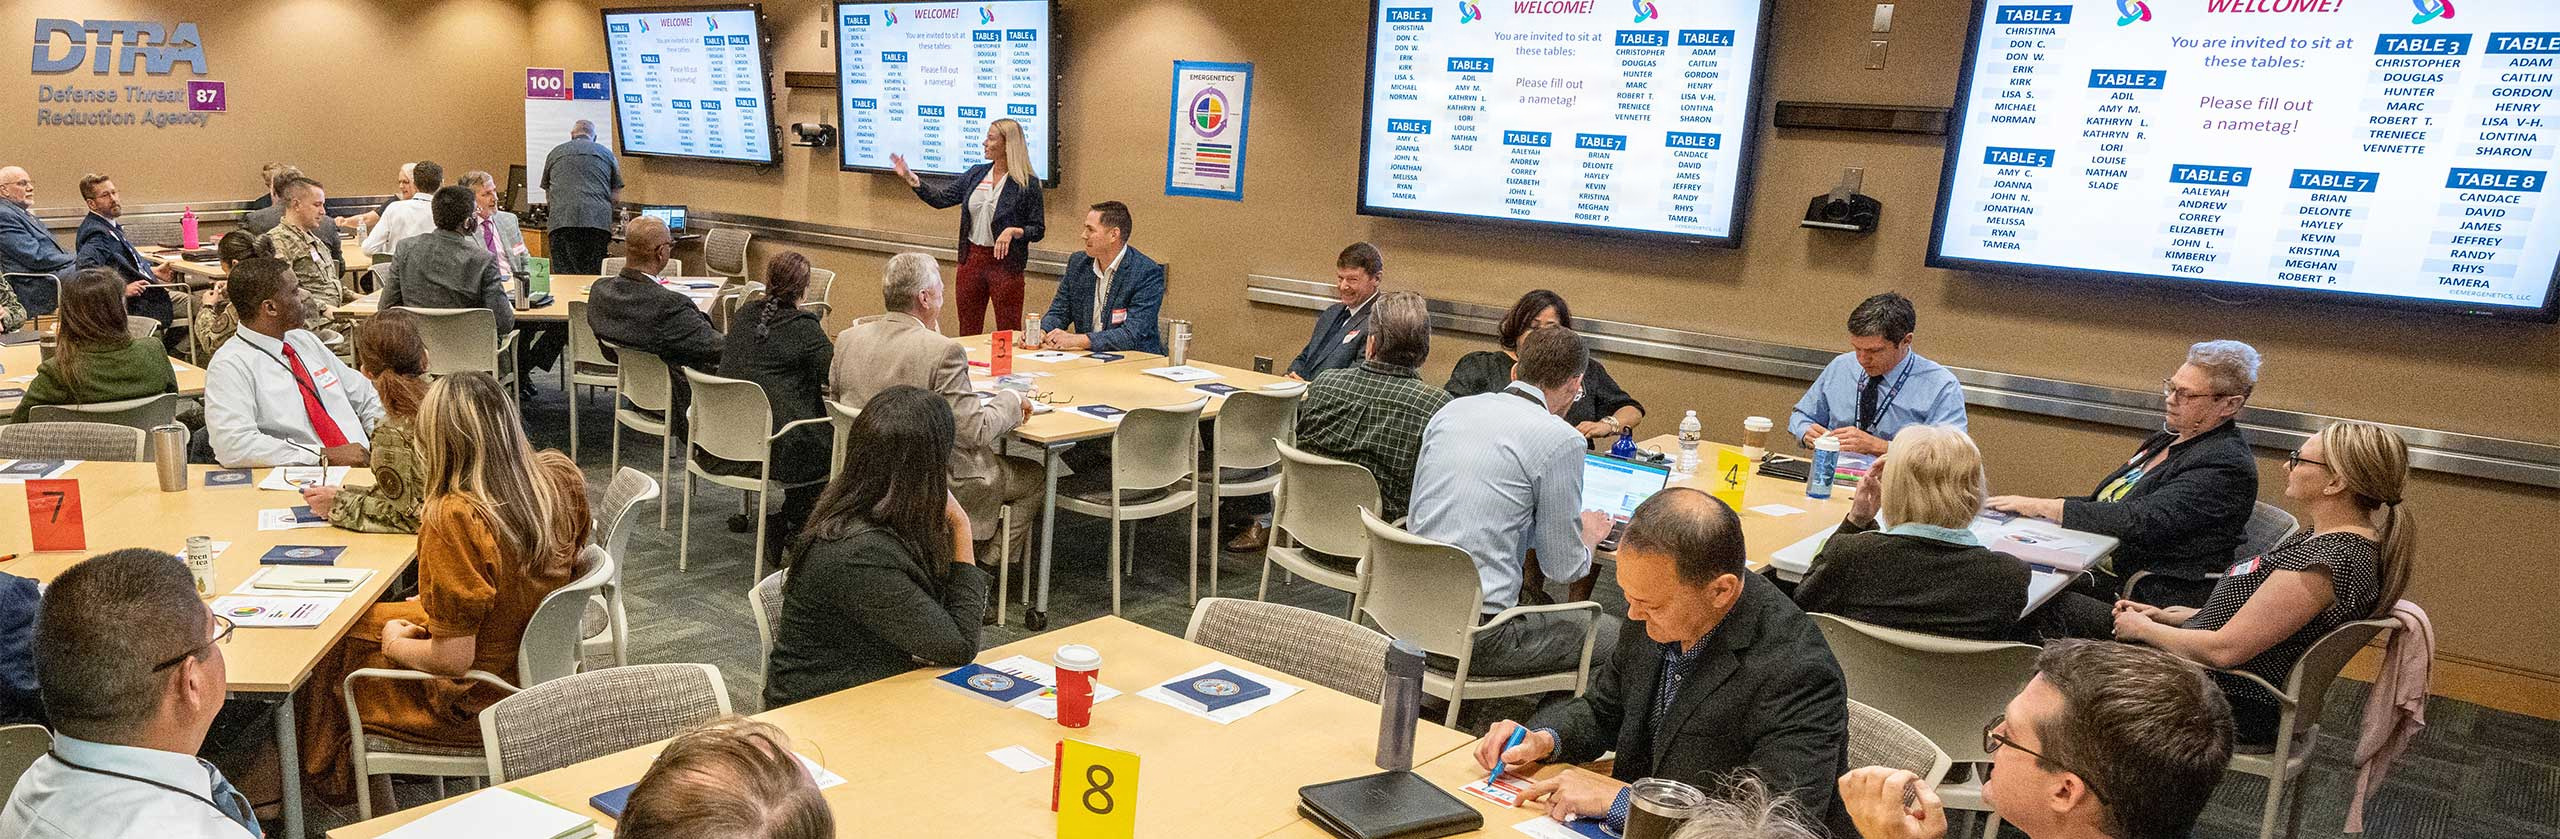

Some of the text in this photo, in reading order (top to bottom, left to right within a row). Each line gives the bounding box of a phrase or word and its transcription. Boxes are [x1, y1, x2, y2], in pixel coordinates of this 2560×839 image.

[1514, 1, 1594, 14] WELCOME!
[2207, 0, 2344, 13] WELCOME!
[914, 8, 959, 19] WELCOME!
[2006, 10, 2062, 22] TABLE 1
[1010, 32, 1029, 40] TABLE
[2005, 27, 2056, 36] CHRISTINA
[975, 33, 994, 41] TABLE
[1494, 32, 1512, 40] You
[1530, 32, 1564, 41] invited
[1566, 33, 1577, 42] to
[1578, 32, 1590, 42] sit
[1592, 33, 1602, 42] at
[1621, 34, 1663, 46] TABLE 3
[1684, 34, 1728, 46] TABLE 4
[31, 18, 208, 75] DTRA
[2010, 40, 2046, 49] DON C.
[2171, 36, 2354, 50] You are invited to sit at
[2386, 38, 2460, 54] TABLE 3
[2497, 37, 2560, 51] TABLE
[1516, 47, 1576, 56] these tables:
[2006, 53, 2045, 61] DON W.
[2204, 55, 2305, 68] these tables:
[2375, 59, 2461, 68] CHRISTOPHER
[2509, 58, 2553, 67] ADAM
[2012, 66, 2034, 74] ERIK
[2009, 78, 2032, 86] KIRK
[2096, 73, 2157, 86] TABLE 2
[2383, 73, 2444, 82] DOUGLAS
[2500, 73, 2553, 82] CAITLIN
[530, 76, 561, 90] 100
[1516, 78, 1583, 89] Please fill out
[38, 84, 184, 104] Defense Threat
[196, 89, 217, 103] 87
[2002, 90, 2034, 99] LISA S.
[2110, 92, 2134, 100] ADIL
[2384, 88, 2435, 97] HUNTER
[2492, 88, 2553, 98] GORDON
[1528, 95, 1576, 106] nametag!
[2200, 96, 2314, 112] Please fill out
[1994, 103, 2037, 112] MICHAEL
[2098, 104, 2141, 114] AMY M.
[2386, 102, 2425, 111] MARC
[2494, 102, 2541, 112] HENRY
[920, 108, 938, 116] TABLE
[37, 109, 209, 129] Reduction Agency
[1991, 115, 2036, 124] NORMAN
[2086, 117, 2148, 127] KATHRYN L.
[2369, 116, 2433, 126] ROBERT T.
[2482, 118, 2544, 128] LISA V-H.
[2202, 120, 2299, 136] a nametag!
[2082, 130, 2146, 140] KATHRYN R.
[2369, 130, 2426, 140] TRENIECE
[2479, 132, 2538, 142] LONTINA
[1671, 135, 1716, 147] TABLE 8
[2100, 143, 2123, 152] LORI
[2362, 144, 2426, 154] VENNETTE
[2476, 146, 2532, 157] SHARON
[1991, 152, 2047, 167] TABLE 5
[2091, 156, 2127, 165] LOUISE
[1997, 168, 2033, 178] AMY C.
[2085, 168, 2128, 178] NATHAN
[2178, 168, 2242, 183] TABLE 6
[1994, 180, 2032, 190] JOANNA
[2299, 174, 2369, 192] TABLE 7
[2456, 172, 2536, 188] TABLE 8
[2088, 181, 2120, 190] SLADE
[1990, 192, 2030, 202] JOHN N.
[2182, 187, 2230, 198] AALEYAH
[2310, 194, 2348, 203] BRIAN
[2458, 192, 2521, 204] CANDACE
[1983, 204, 2034, 215] JONATHAN
[2178, 200, 2228, 210] ANDREW
[2299, 206, 2352, 218] DELONTE
[2464, 207, 2506, 218] DAVID
[1986, 216, 2026, 226] MELISSA
[2179, 212, 2222, 223] CORREY
[2300, 220, 2344, 230] HAYLEY
[2458, 222, 2502, 232] JAMES
[1991, 228, 2016, 238] RYAN
[2169, 225, 2225, 237] ELIZABETH
[2300, 233, 2336, 244] KEVIN
[2450, 235, 2503, 247] JEFFREY
[1982, 240, 2020, 250] TAMERA
[2171, 238, 2214, 250] JOHN L.
[2164, 250, 2217, 262] KIMBERLY
[2288, 246, 2341, 258] KRISTINA
[2450, 250, 2496, 260] RANDY
[536, 262, 544, 278] 2
[2171, 264, 2204, 274] TAEKO
[2284, 259, 2338, 271] MEGHAN
[2452, 264, 2485, 274] RHYS
[2278, 272, 2337, 284] ROBERT P.
[2438, 276, 2490, 289] TAMERA
[997, 338, 1006, 358] 3
[1724, 464, 1738, 490] 4
[42, 492, 64, 524] 7
[1082, 764, 1114, 815] 8
